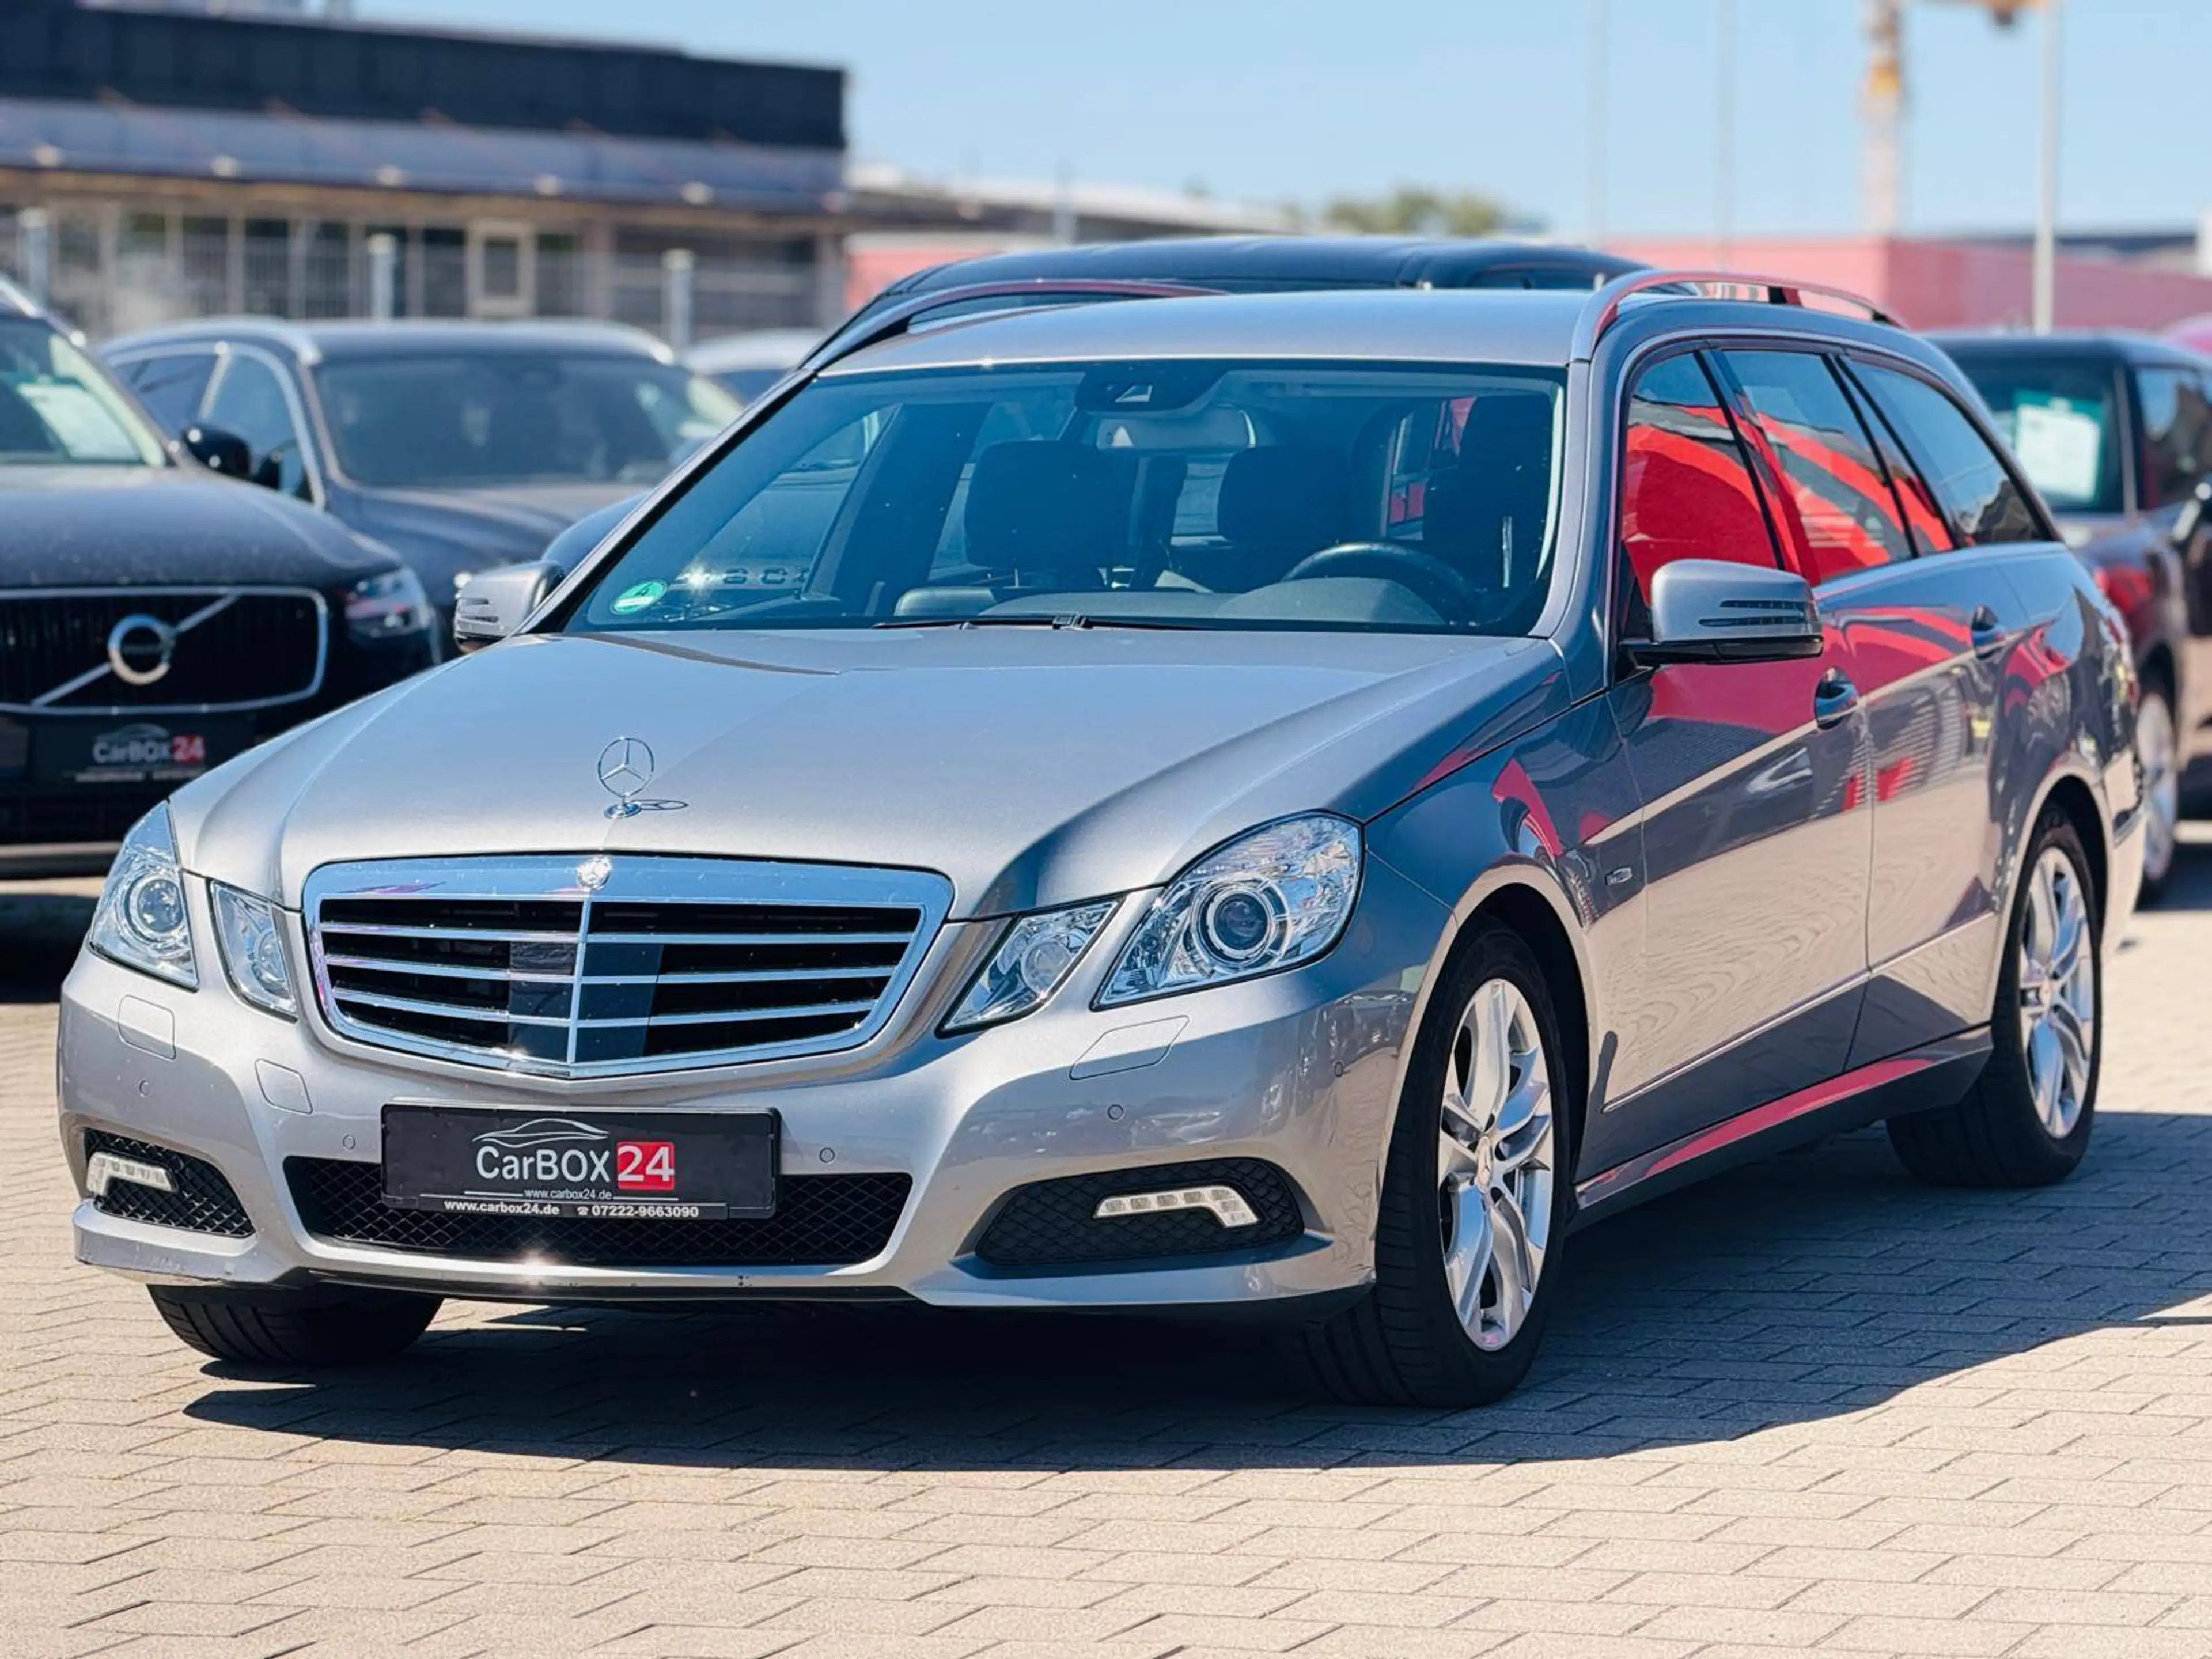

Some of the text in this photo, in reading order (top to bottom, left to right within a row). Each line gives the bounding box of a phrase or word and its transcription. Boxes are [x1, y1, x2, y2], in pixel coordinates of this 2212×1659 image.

[618, 1145, 675, 1182] 24
[524, 1188, 613, 1200] www.carbox24.de
[444, 1200, 699, 1218] www.carbox24.de 07222-9663090
